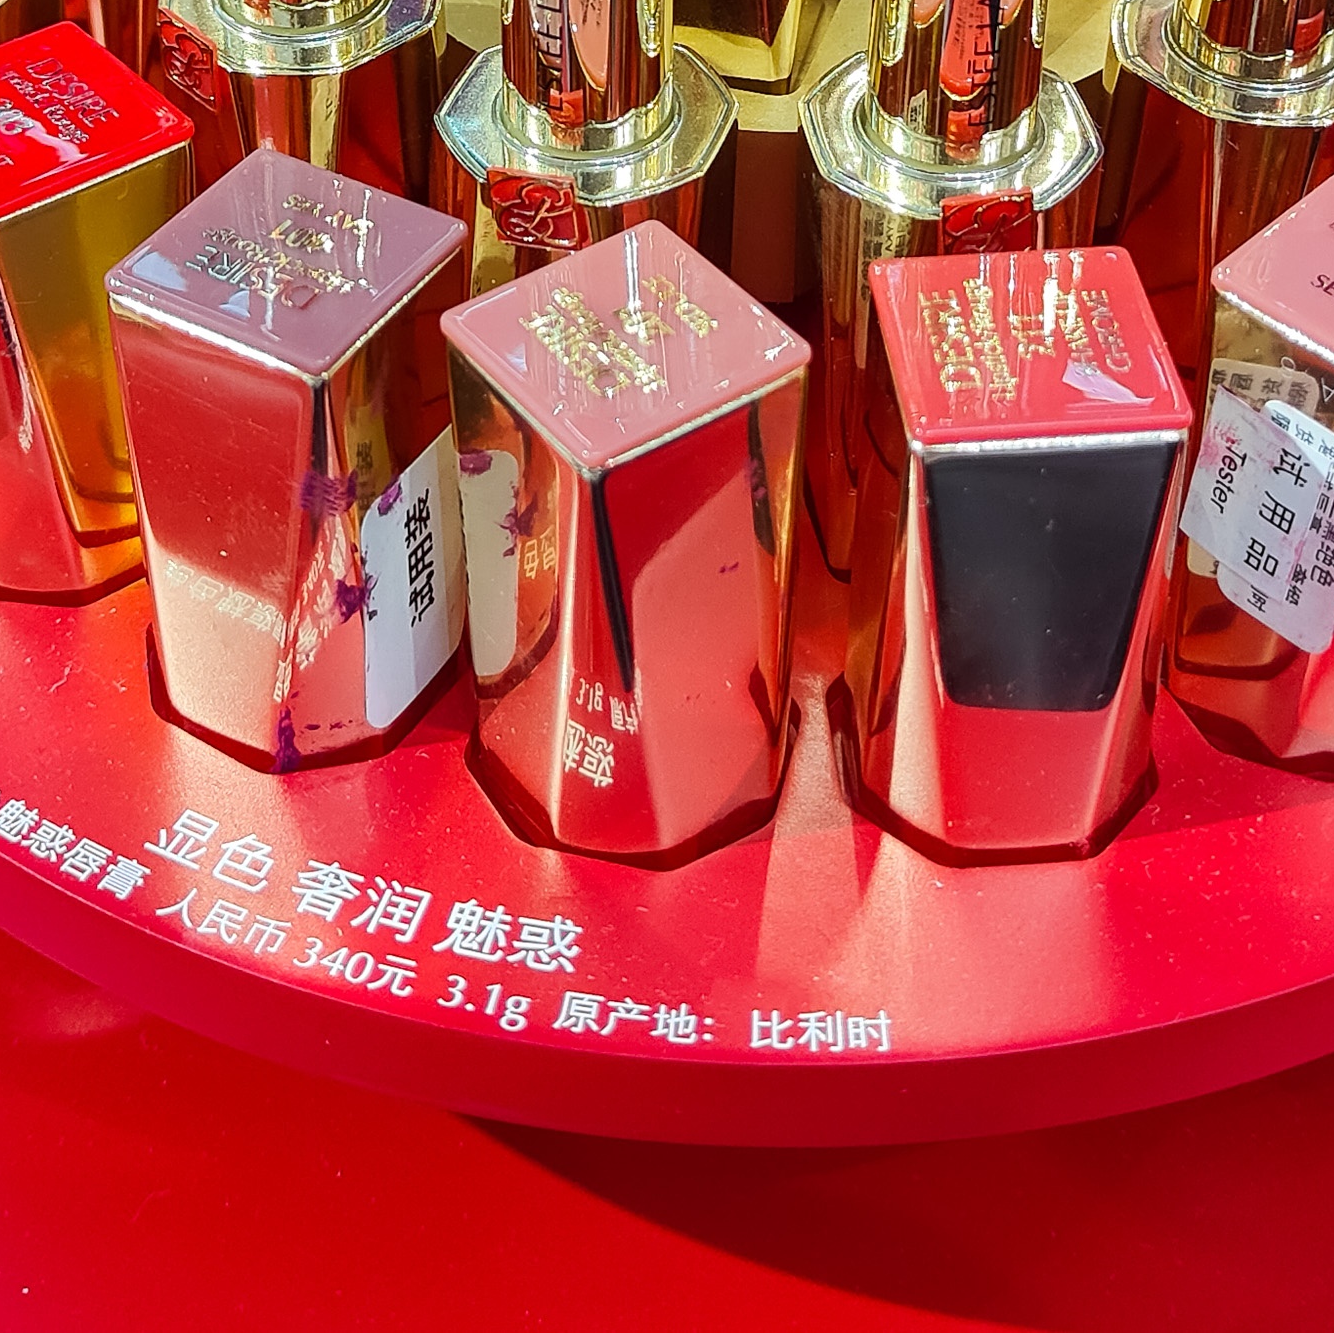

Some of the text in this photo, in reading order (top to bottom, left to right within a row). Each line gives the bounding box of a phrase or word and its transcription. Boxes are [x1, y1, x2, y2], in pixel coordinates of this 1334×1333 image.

[24, 58, 121, 129] DESIRE
[185, 244, 323, 310] DESIRE
[1081, 289, 1131, 373] CHROME
[1210, 445, 1248, 515] Tester
[1243, 446, 1312, 577] 试用品
[405, 487, 436, 627] 试用装
[145, 808, 583, 975] 显色 奢润 魅惑
[155, 886, 288, 958] 人民币
[290, 934, 417, 999] 340元
[436, 974, 531, 1031] 3.1g
[749, 1007, 894, 1054] 比利时
